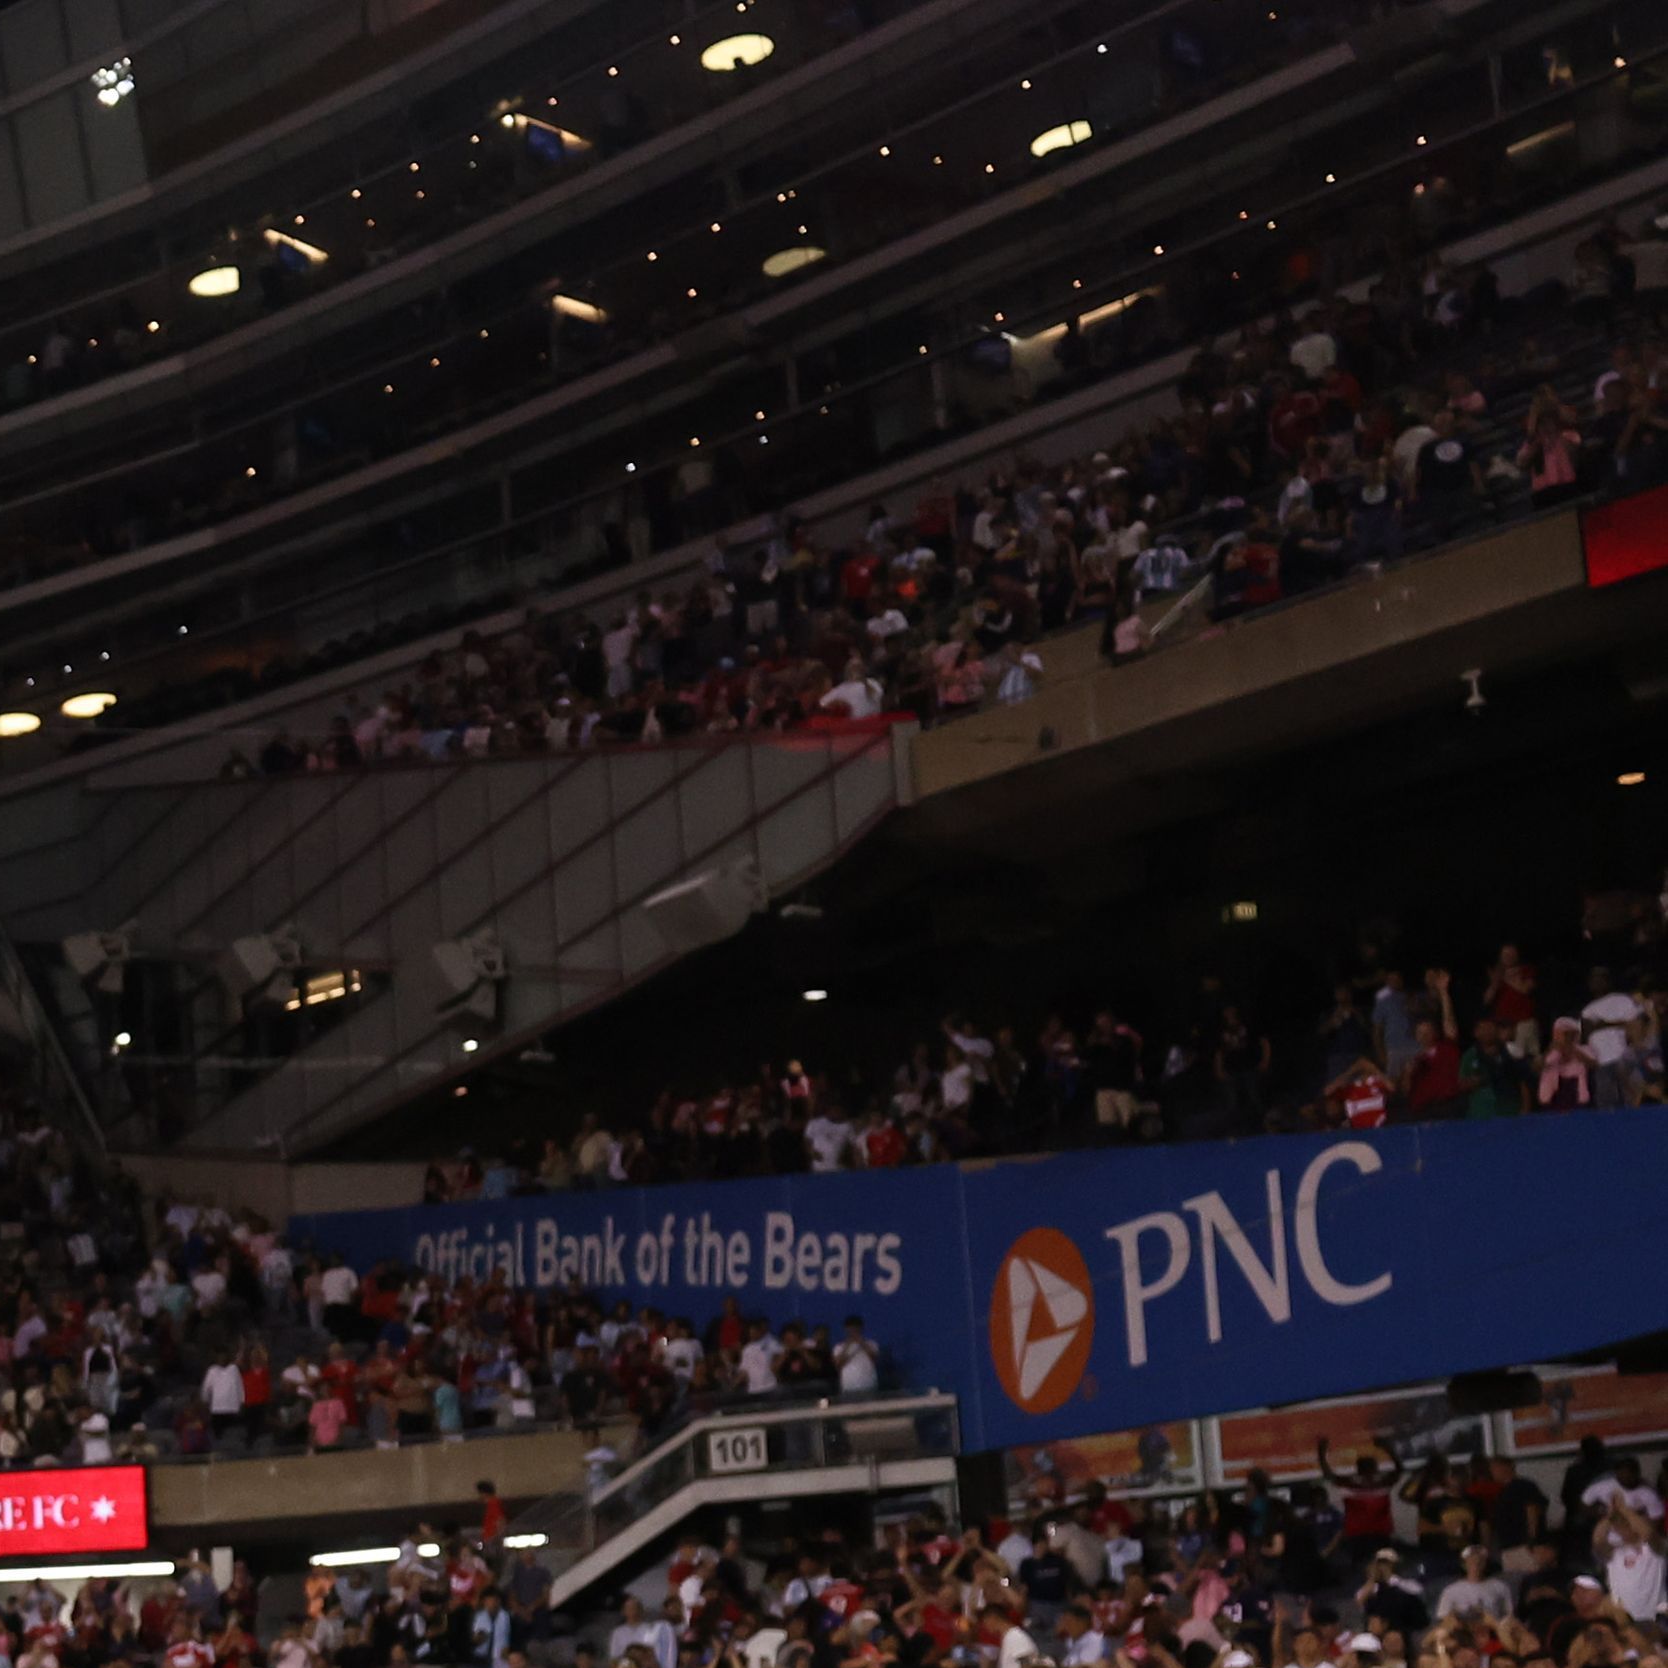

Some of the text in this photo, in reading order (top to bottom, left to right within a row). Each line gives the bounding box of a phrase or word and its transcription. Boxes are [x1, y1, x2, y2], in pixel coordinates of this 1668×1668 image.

[415, 1210, 904, 1296] Official Bank of the Bears
[1104, 1140, 1394, 1368] PNC
[716, 1430, 763, 1466] 101
[33, 1493, 80, 1530] FC
